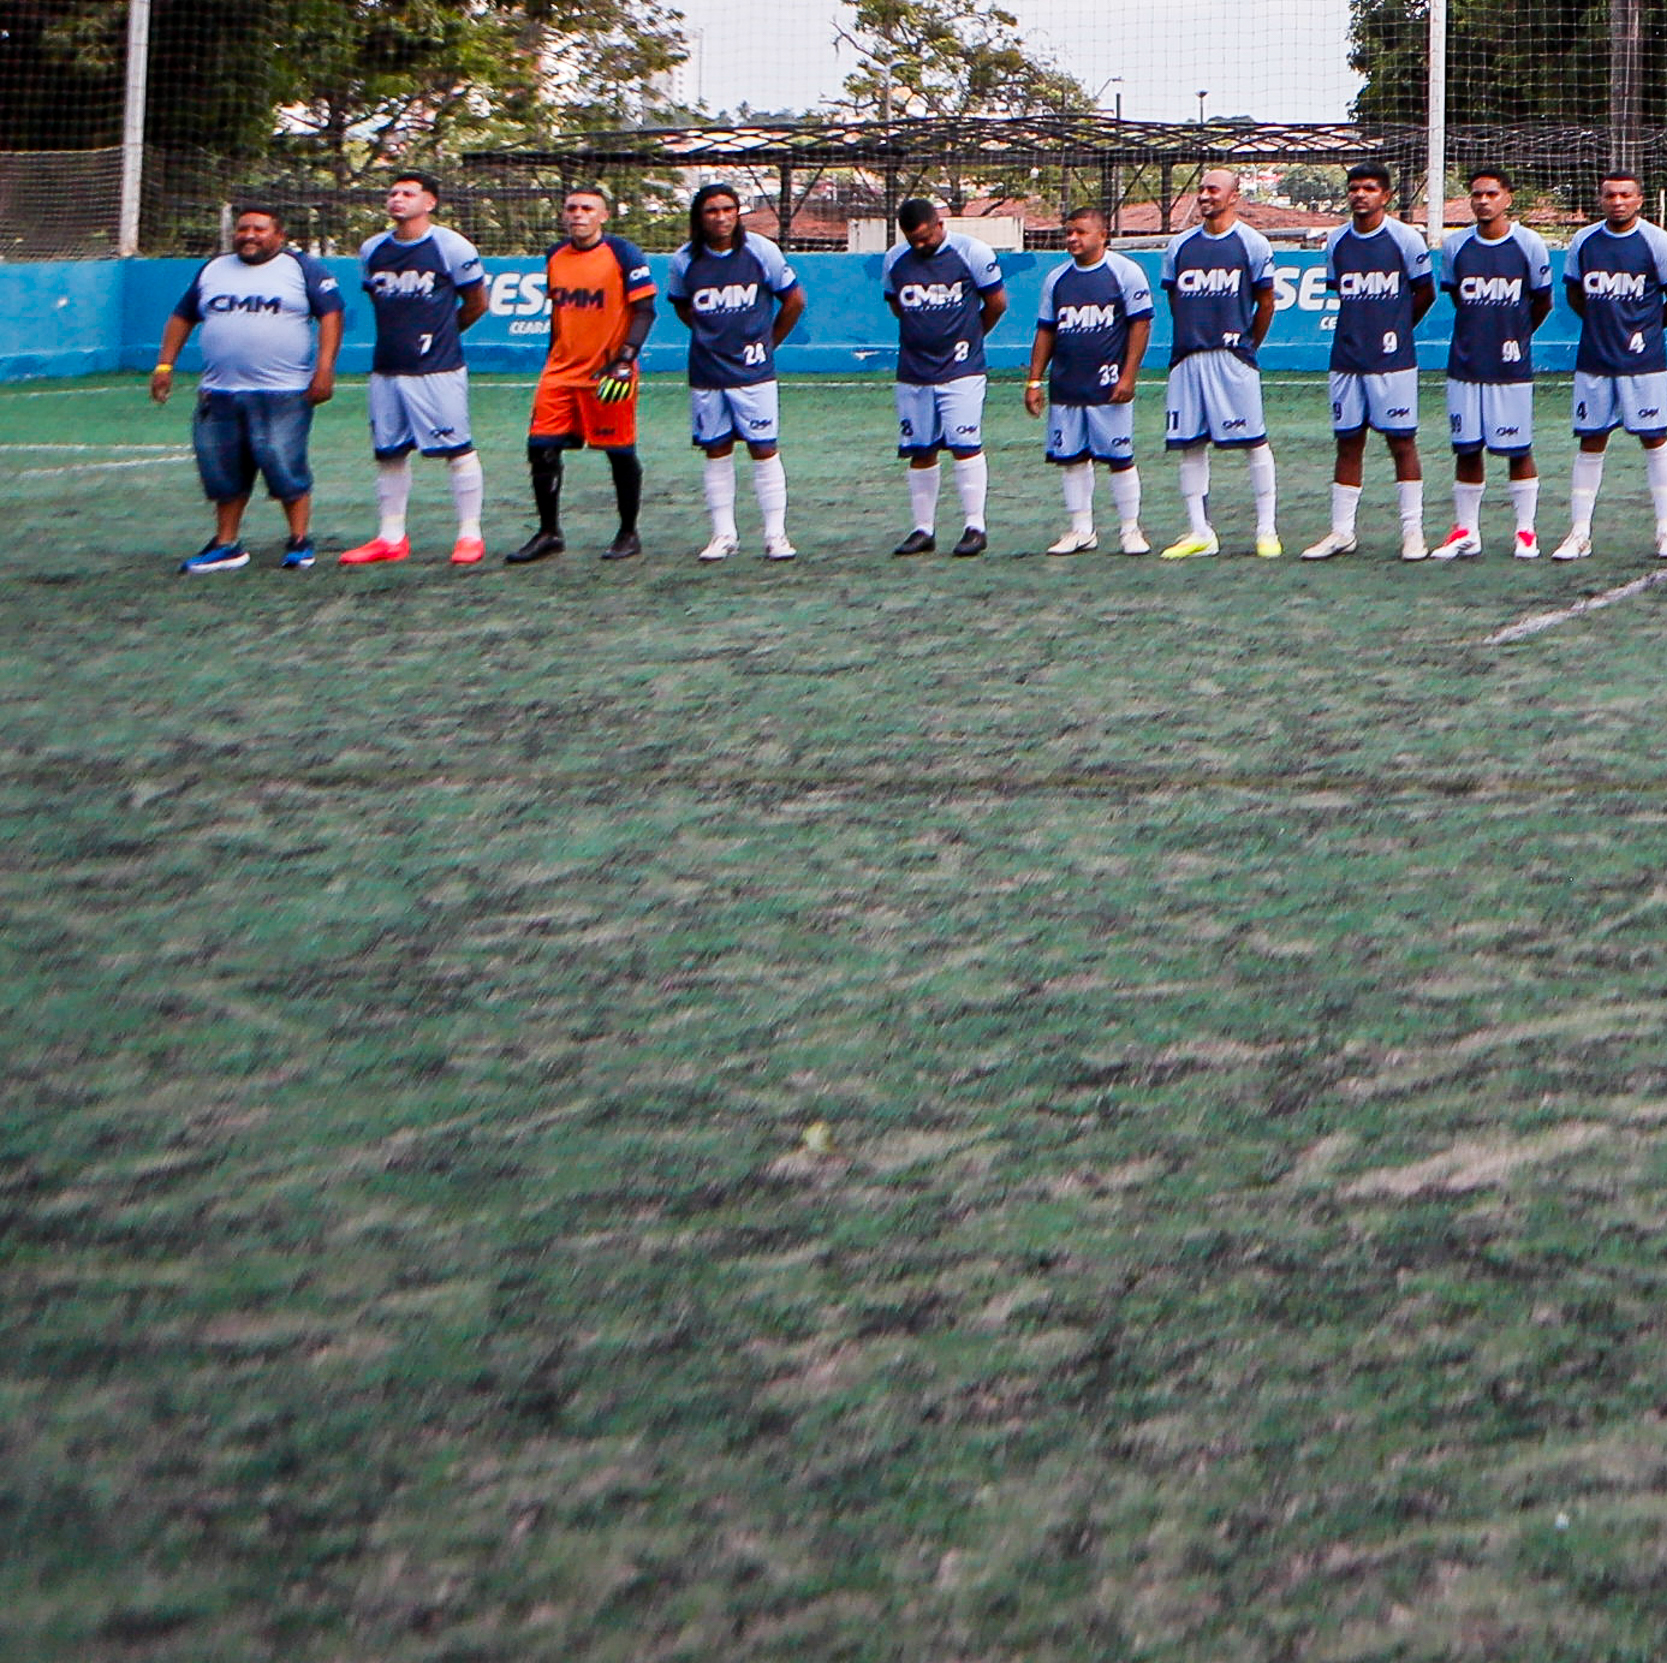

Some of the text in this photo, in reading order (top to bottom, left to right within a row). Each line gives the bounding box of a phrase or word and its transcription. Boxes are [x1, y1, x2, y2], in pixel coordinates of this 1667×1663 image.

[372, 270, 435, 293] CMM
[1177, 268, 1242, 292] CMM
[1340, 270, 1400, 295] CMM
[1460, 276, 1523, 302] CMM
[1583, 270, 1646, 297] CMM
[207, 293, 282, 314] CMM
[693, 283, 758, 311] CMM
[900, 281, 963, 306] CMM
[1057, 304, 1115, 329] CMM
[419, 333, 434, 356] 7
[1382, 330, 1398, 354] 9
[1628, 331, 1646, 354] 4
[1098, 363, 1120, 386] 33
[1576, 400, 1588, 420] 4
